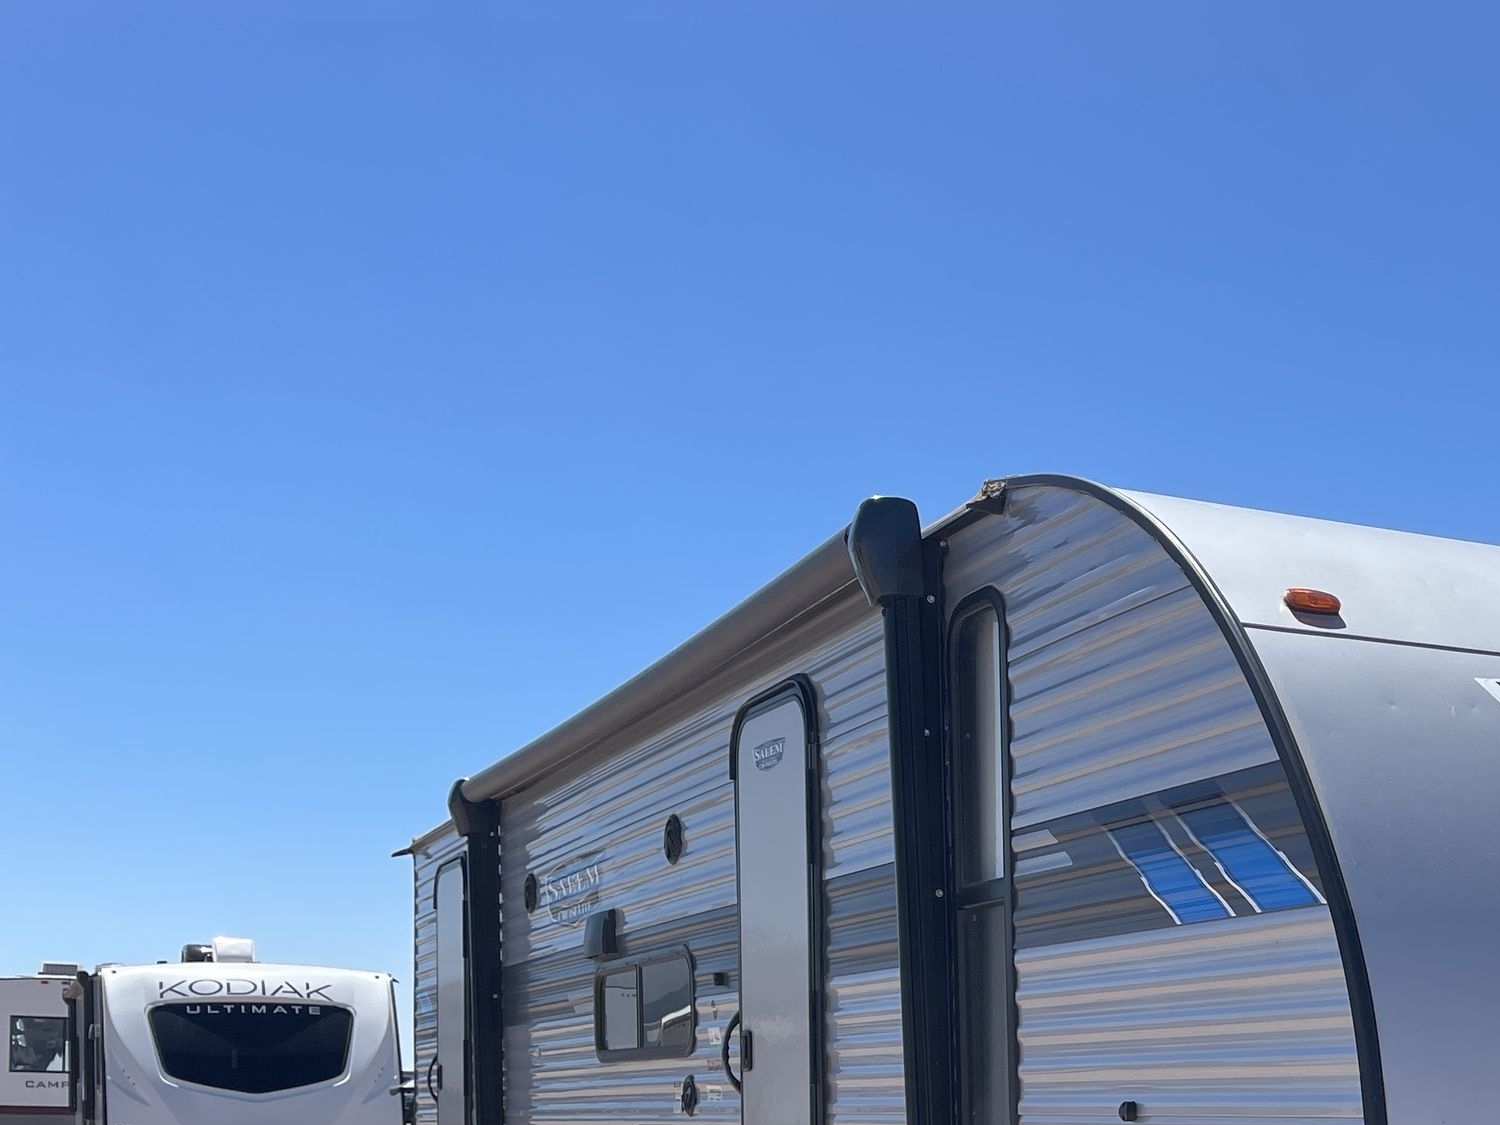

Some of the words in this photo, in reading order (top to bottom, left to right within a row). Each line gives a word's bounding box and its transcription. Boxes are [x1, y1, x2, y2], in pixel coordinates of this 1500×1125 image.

[754, 743, 783, 761] SALEM
[158, 979, 333, 1002] KODIAK
[186, 1004, 321, 1015] ULTIMATE
